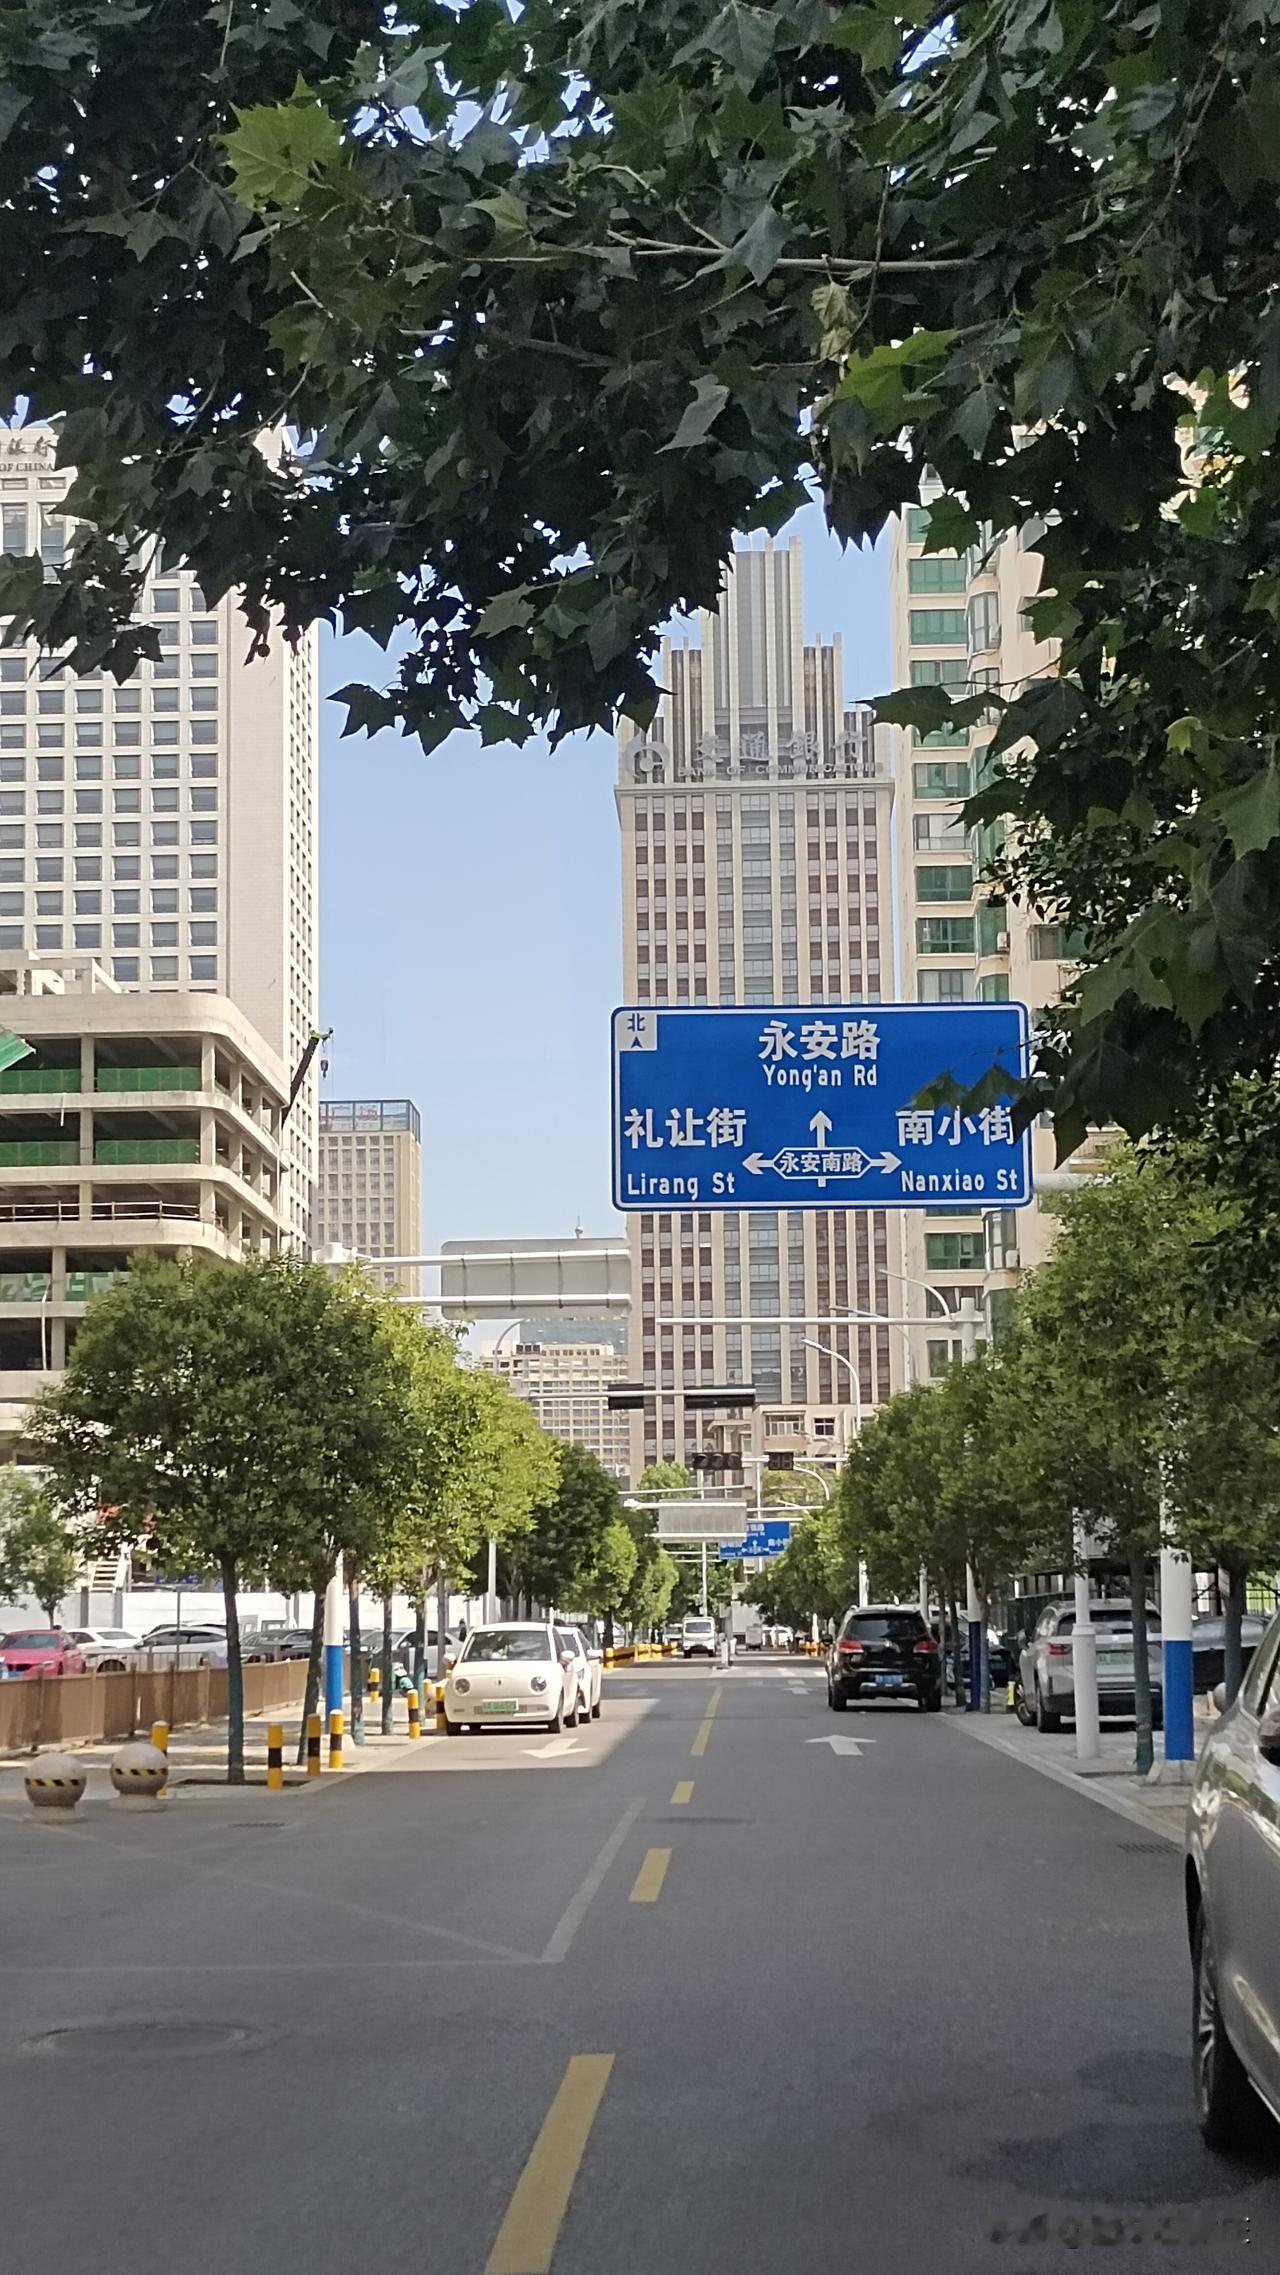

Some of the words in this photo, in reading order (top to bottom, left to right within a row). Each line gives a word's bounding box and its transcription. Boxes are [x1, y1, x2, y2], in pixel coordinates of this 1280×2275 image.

[16, 462, 54, 472] CHINA
[693, 730, 868, 763] 交通银行
[726, 765, 746, 776] OF
[627, 1013, 646, 1032] 北
[758, 1019, 881, 1062] 永安路
[762, 1064, 842, 1093] Yong'an
[853, 1064, 877, 1086] Rd
[624, 1107, 747, 1149] 礼让街
[895, 1105, 1015, 1146] 南小街
[780, 1152, 863, 1173] 永安南路
[627, 1172, 698, 1201] Lirang
[712, 1171, 735, 1194] St
[901, 1168, 985, 1192] Nanxiao
[996, 1168, 1018, 1191] St
